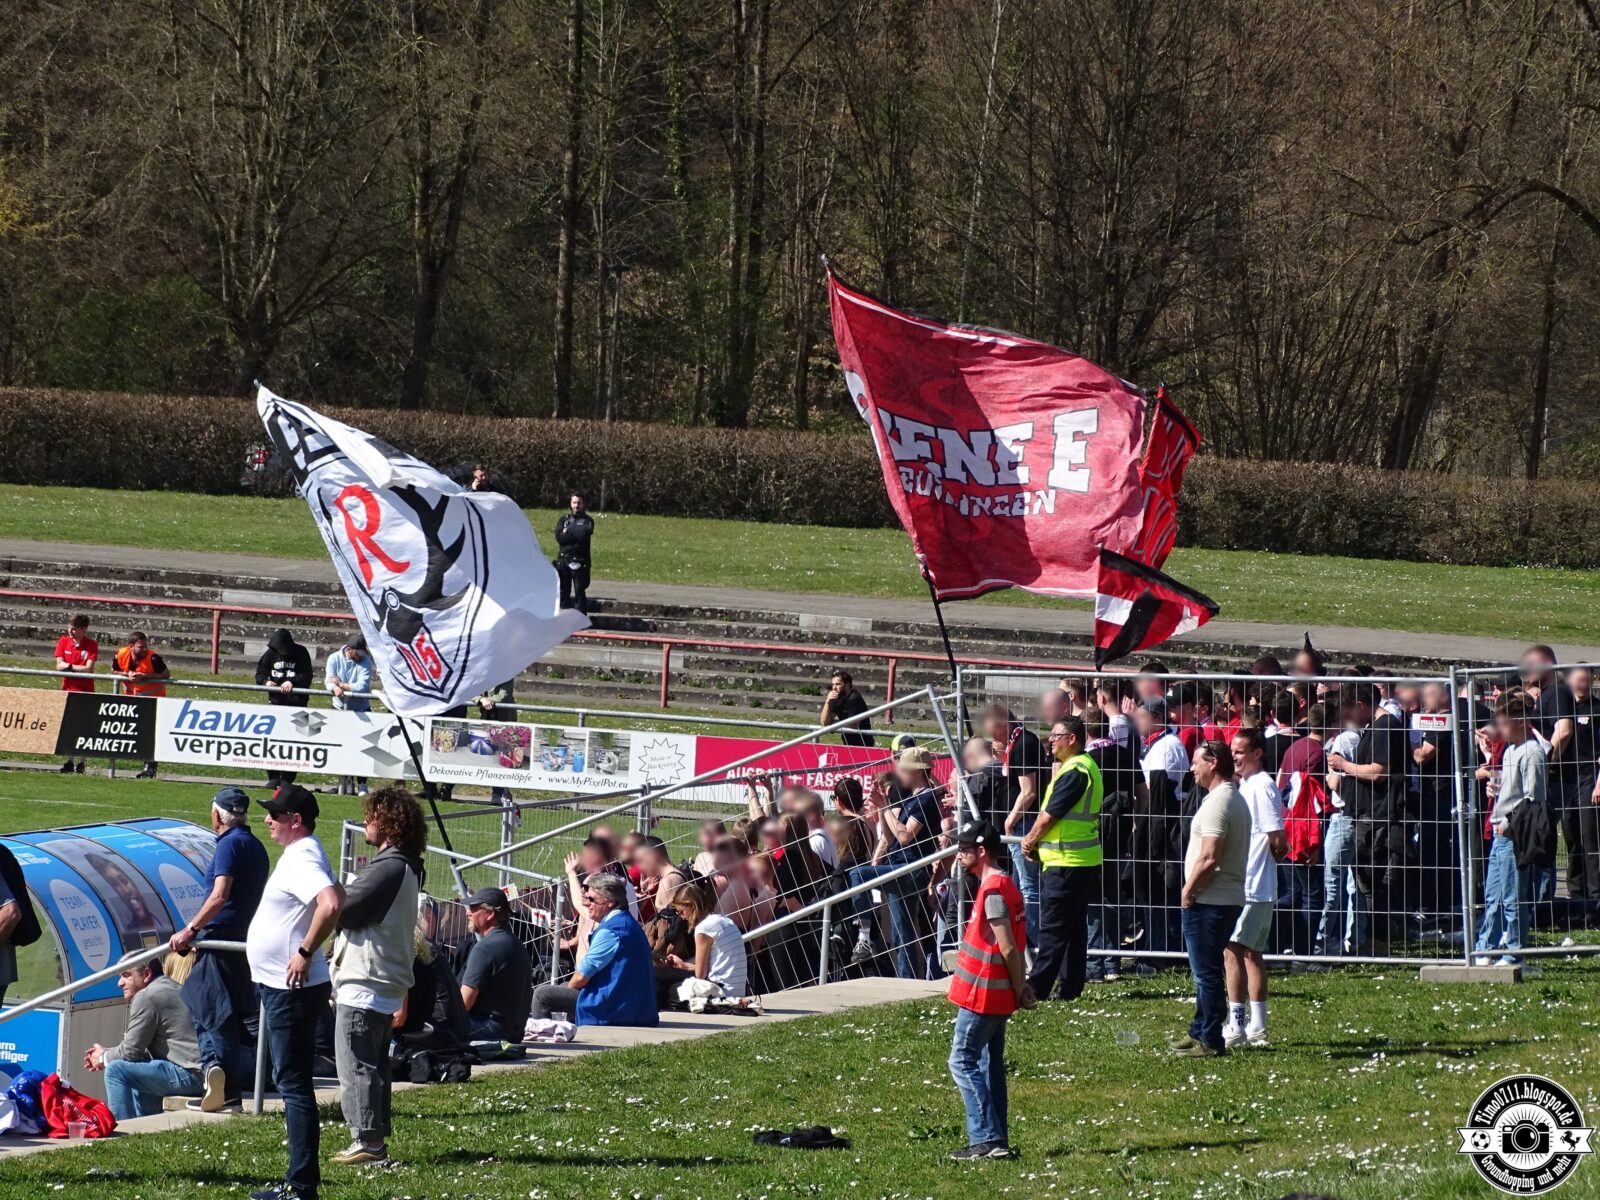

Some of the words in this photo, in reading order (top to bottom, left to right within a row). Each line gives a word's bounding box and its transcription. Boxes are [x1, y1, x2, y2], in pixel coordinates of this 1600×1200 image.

[332, 483, 411, 590] R
[98, 702, 139, 718] KORK.
[174, 700, 277, 735] hawa
[0, 711, 47, 732] UH.de
[99, 720, 138, 736] HOLZ.
[75, 736, 138, 754] PARKETT.
[174, 737, 328, 769] verpackung
[428, 765, 473, 778] Dekorative
[476, 768, 533, 783] Pflanzentöpfe
[548, 776, 629, 789] www.MyPixelPot.eu
